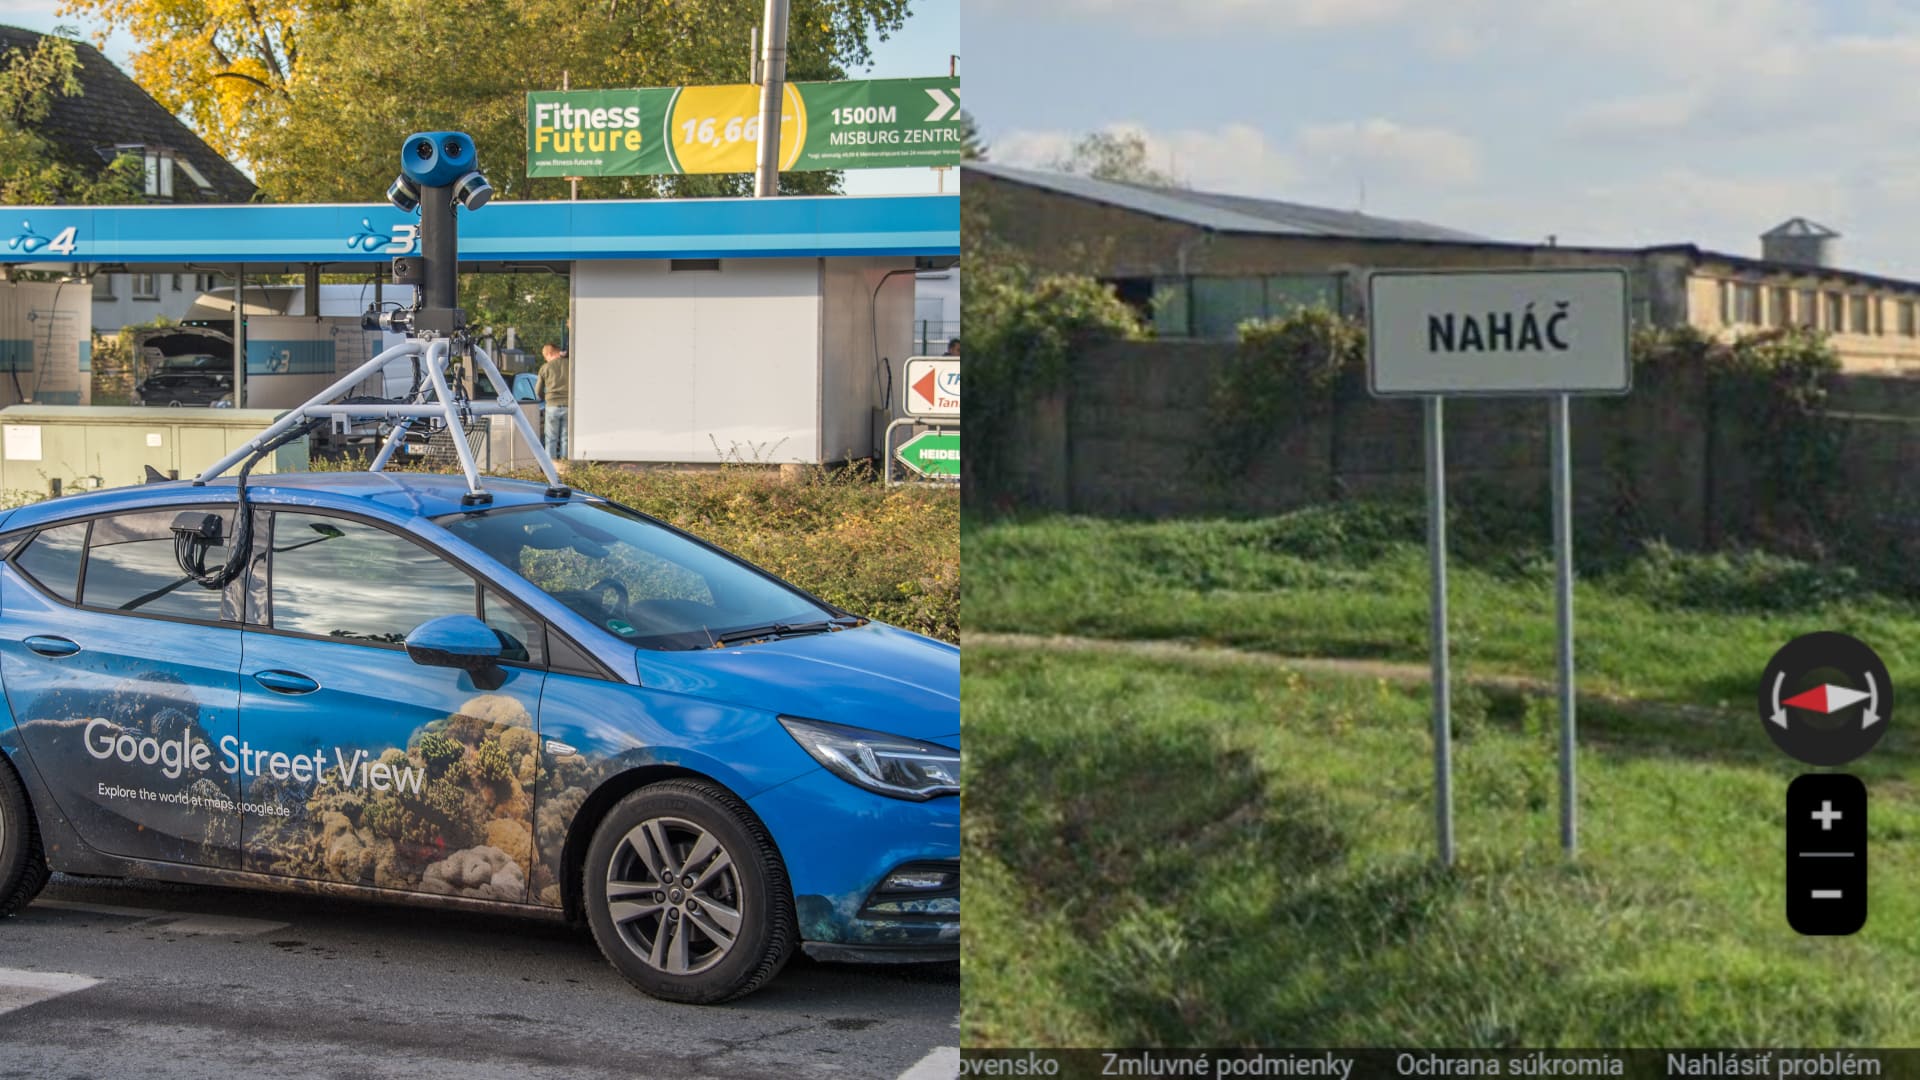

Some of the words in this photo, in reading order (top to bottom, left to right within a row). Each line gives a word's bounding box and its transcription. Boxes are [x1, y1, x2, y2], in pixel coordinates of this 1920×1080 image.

[535, 102, 641, 130] Fitness
[831, 106, 897, 125] 1500M
[535, 126, 643, 153] Future
[830, 129, 900, 146] MISBURG
[47, 226, 77, 256] 4
[385, 224, 418, 254] 3
[1428, 301, 1570, 353] NAHÁČ
[83, 717, 212, 779] Google
[219, 735, 327, 784] Street
[334, 747, 425, 794] View
[98, 783, 137, 799] Explore
[139, 788, 157, 801] the
[158, 791, 189, 805] world
[191, 796, 203, 807] at
[204, 797, 290, 817] maps.google.de
